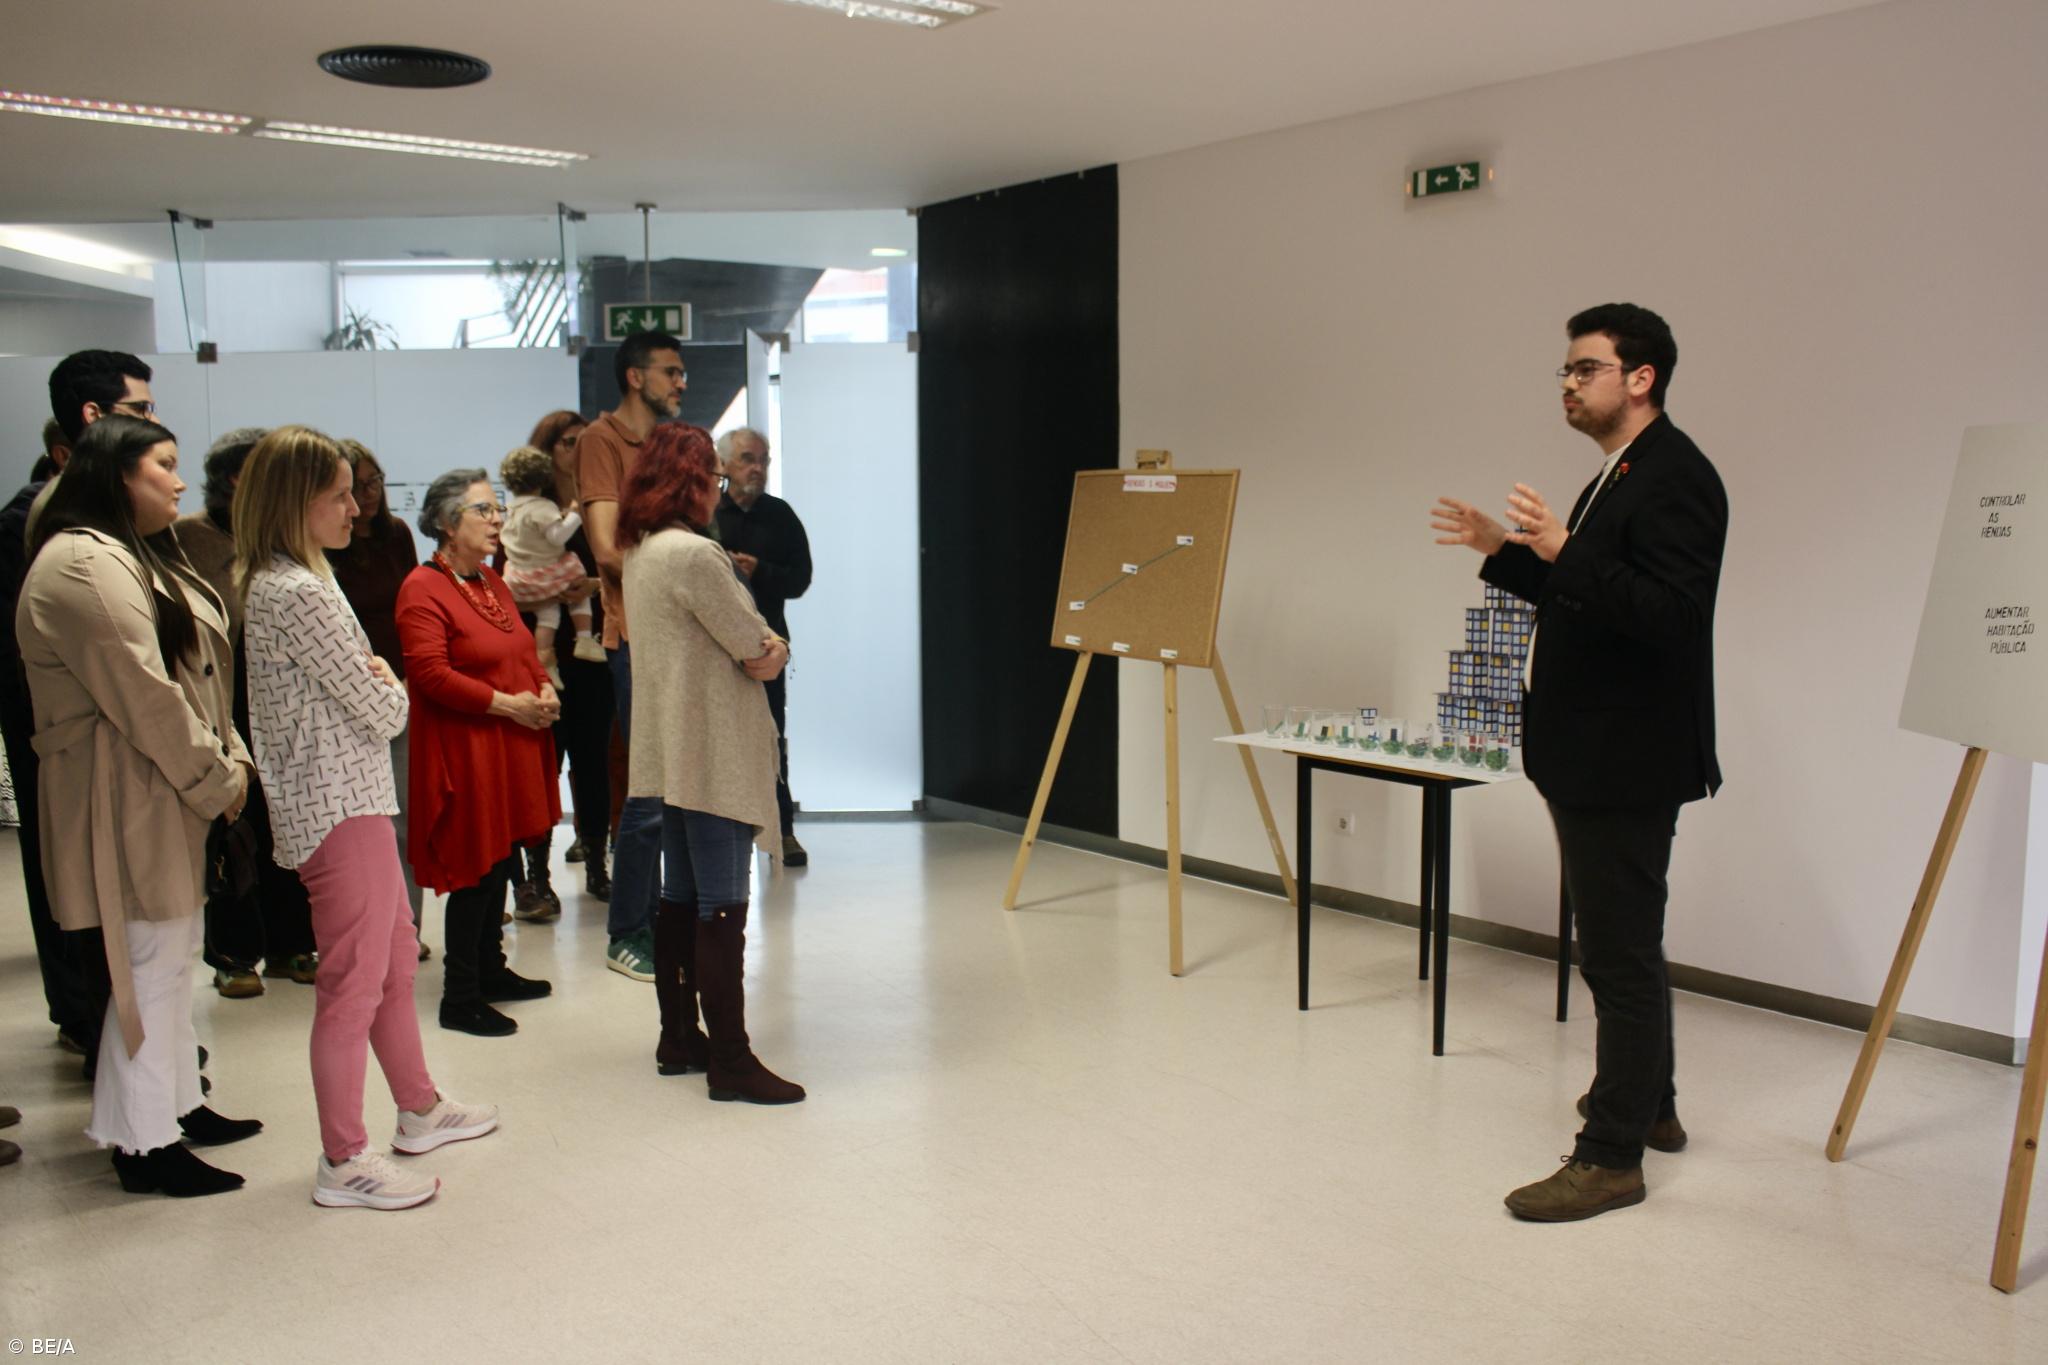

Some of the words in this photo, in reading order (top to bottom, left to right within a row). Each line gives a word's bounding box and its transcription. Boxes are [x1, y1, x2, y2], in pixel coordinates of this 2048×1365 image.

[1979, 494, 2026, 508] CONTROLAR
[1988, 512, 1999, 523] AS
[1980, 526, 2012, 538] RENDAS
[1985, 606, 2030, 619] AUMENTAR
[1990, 640, 2026, 654] PÚBLICA
